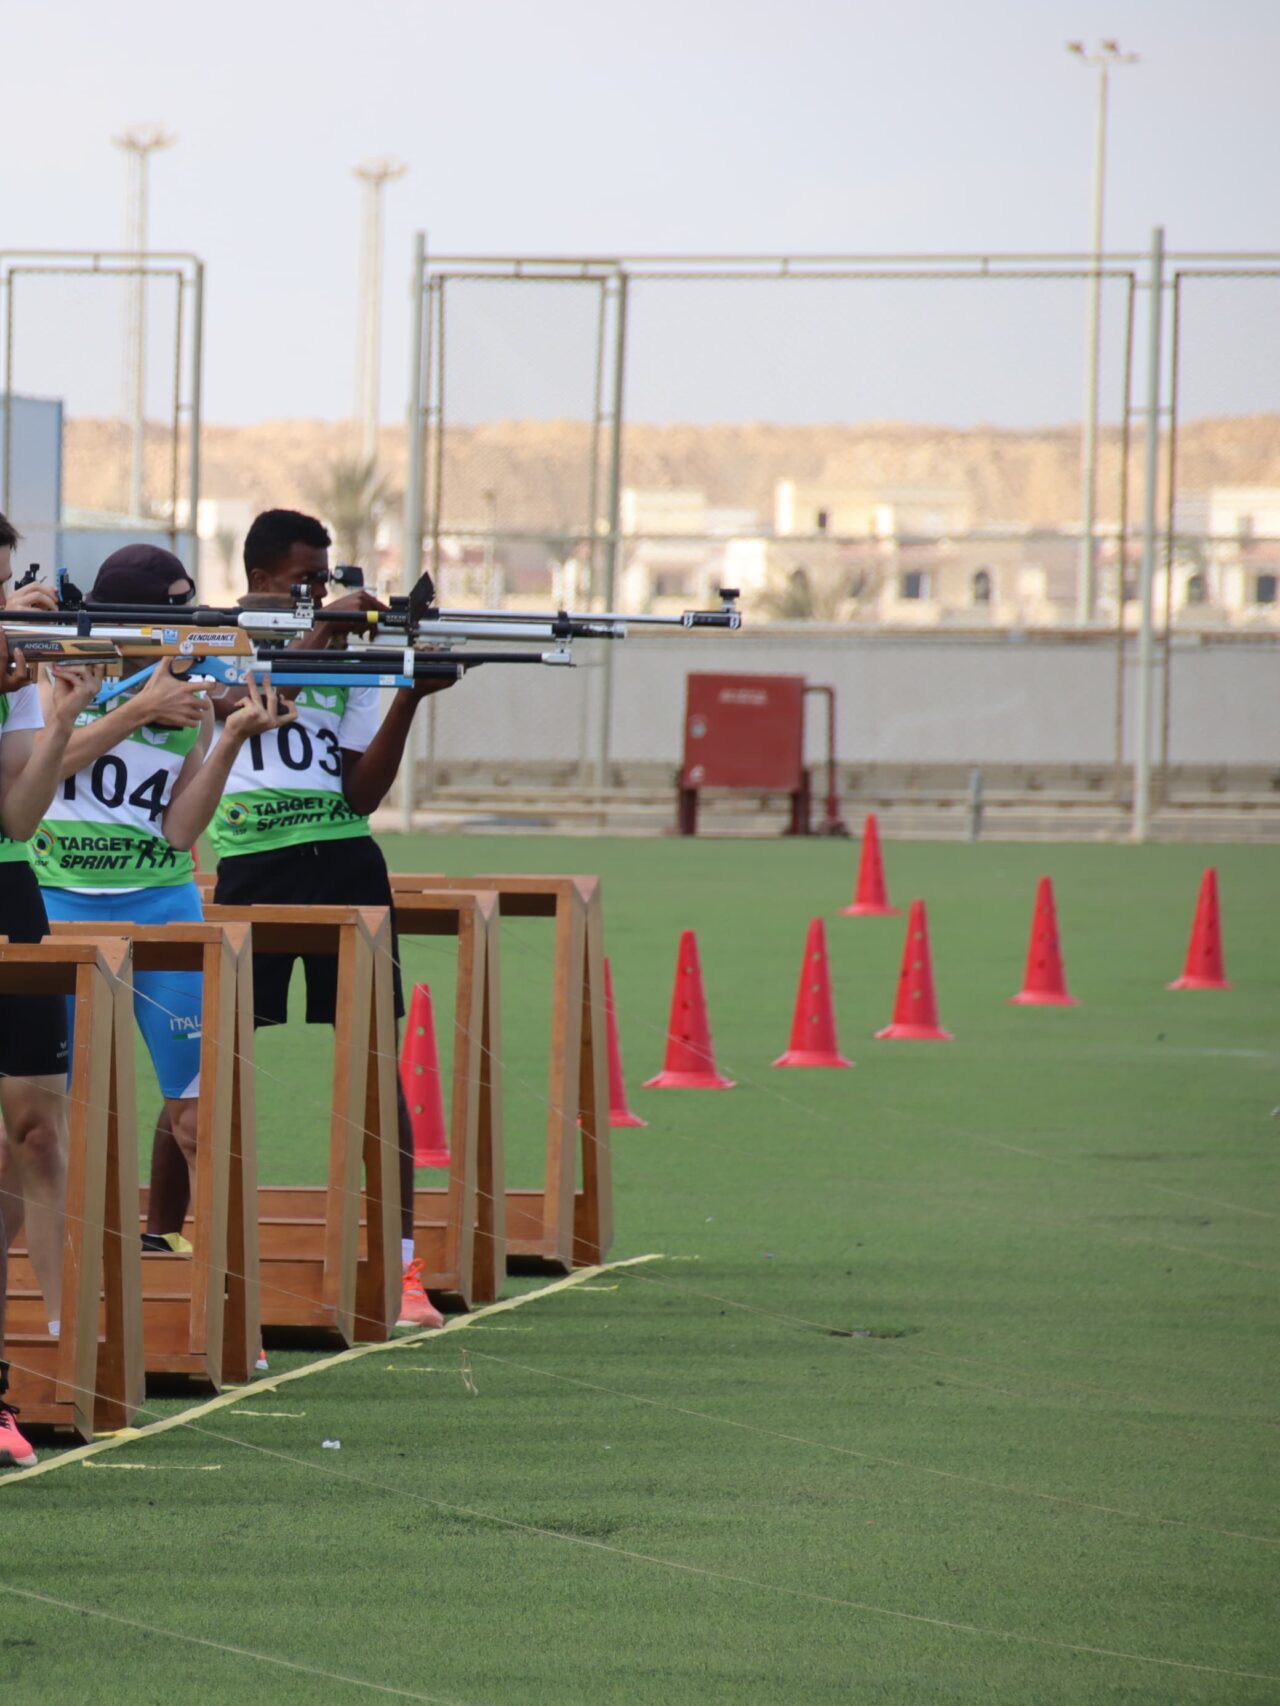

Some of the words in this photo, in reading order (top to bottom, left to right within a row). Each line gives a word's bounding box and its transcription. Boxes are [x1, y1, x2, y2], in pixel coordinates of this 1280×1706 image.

[187, 632, 235, 641] 4ENDURANCE
[252, 796, 324, 817] TARGET
[256, 812, 326, 833] SPRINT
[57, 836, 135, 851] TARGET
[59, 854, 134, 870] SPRINT
